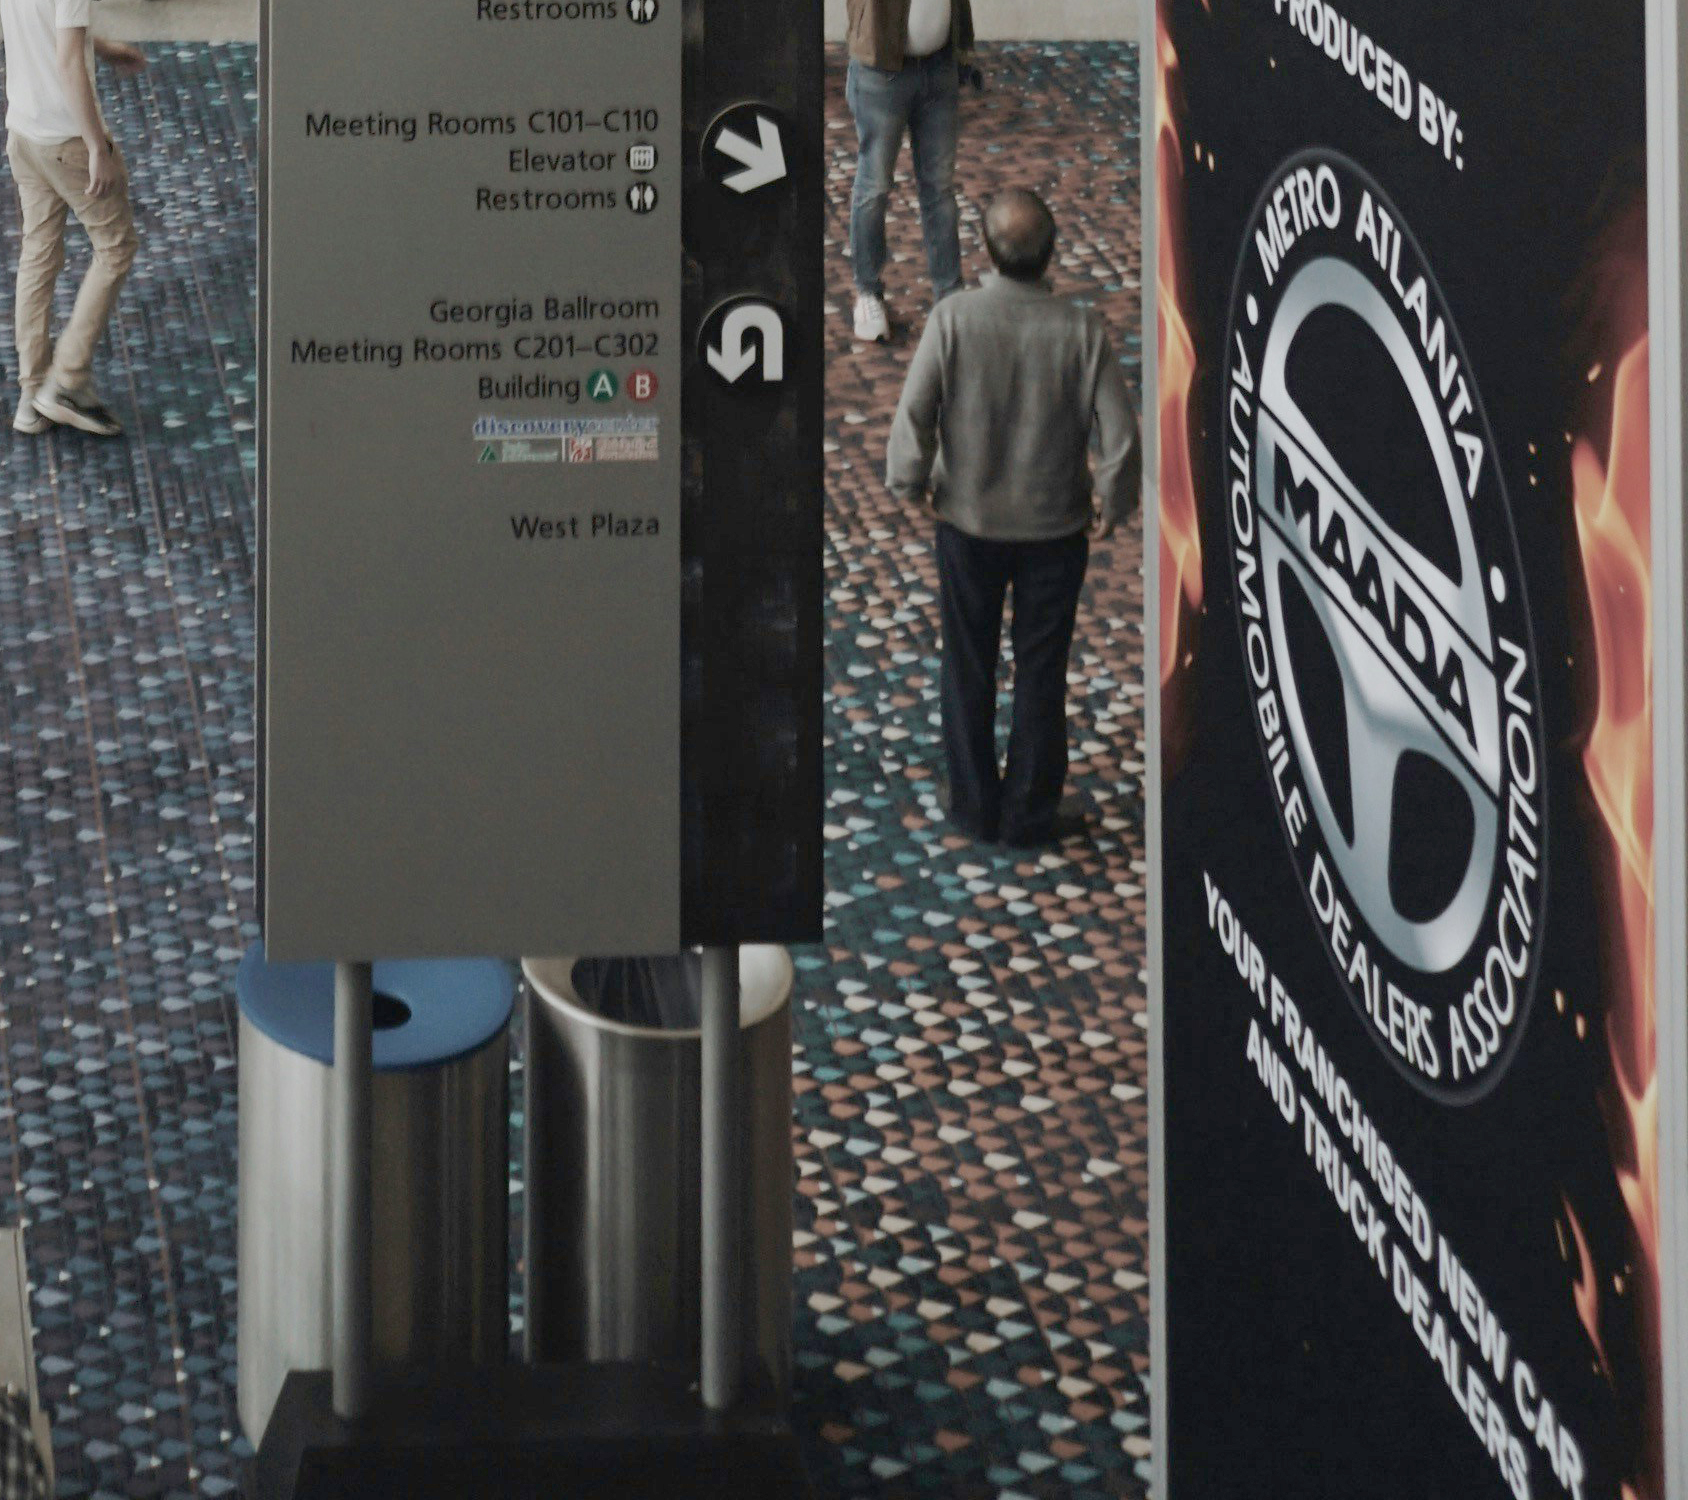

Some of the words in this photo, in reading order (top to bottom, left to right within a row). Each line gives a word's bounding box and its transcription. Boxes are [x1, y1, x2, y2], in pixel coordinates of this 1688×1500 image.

[306, 114, 416, 141] Meeting
[429, 113, 516, 135] Rooms
[1418, 82, 1464, 170] BY:
[509, 148, 616, 171] Elevator
[476, 188, 616, 210] Restrooms
[430, 299, 533, 327] Georgia
[545, 297, 659, 320] Ballroom
[1256, 165, 1341, 285] METRO
[1355, 191, 1485, 499] ATLANTA
[292, 339, 402, 367] Meeting
[414, 338, 502, 361] Rooms
[479, 375, 580, 402] Building
[592, 374, 613, 397] A
[635, 375, 650, 397] B
[511, 517, 578, 538] West
[591, 514, 659, 537] Plaza
[1229, 330, 1308, 847] AUTOMOBILE
[1312, 852, 1440, 1080] DEALERS
[1449, 636, 1539, 1080] ASSOCIATION
[1204, 871, 1265, 1008] YOUR
[1271, 984, 1433, 1262] FRANCHISED
[1439, 1234, 1508, 1382] NEW
[1514, 1359, 1584, 1500] CAR
[1246, 1019, 1299, 1125] AND
[1299, 1097, 1388, 1280] TRUCK
[1393, 1243, 1531, 1500] DEALERS
